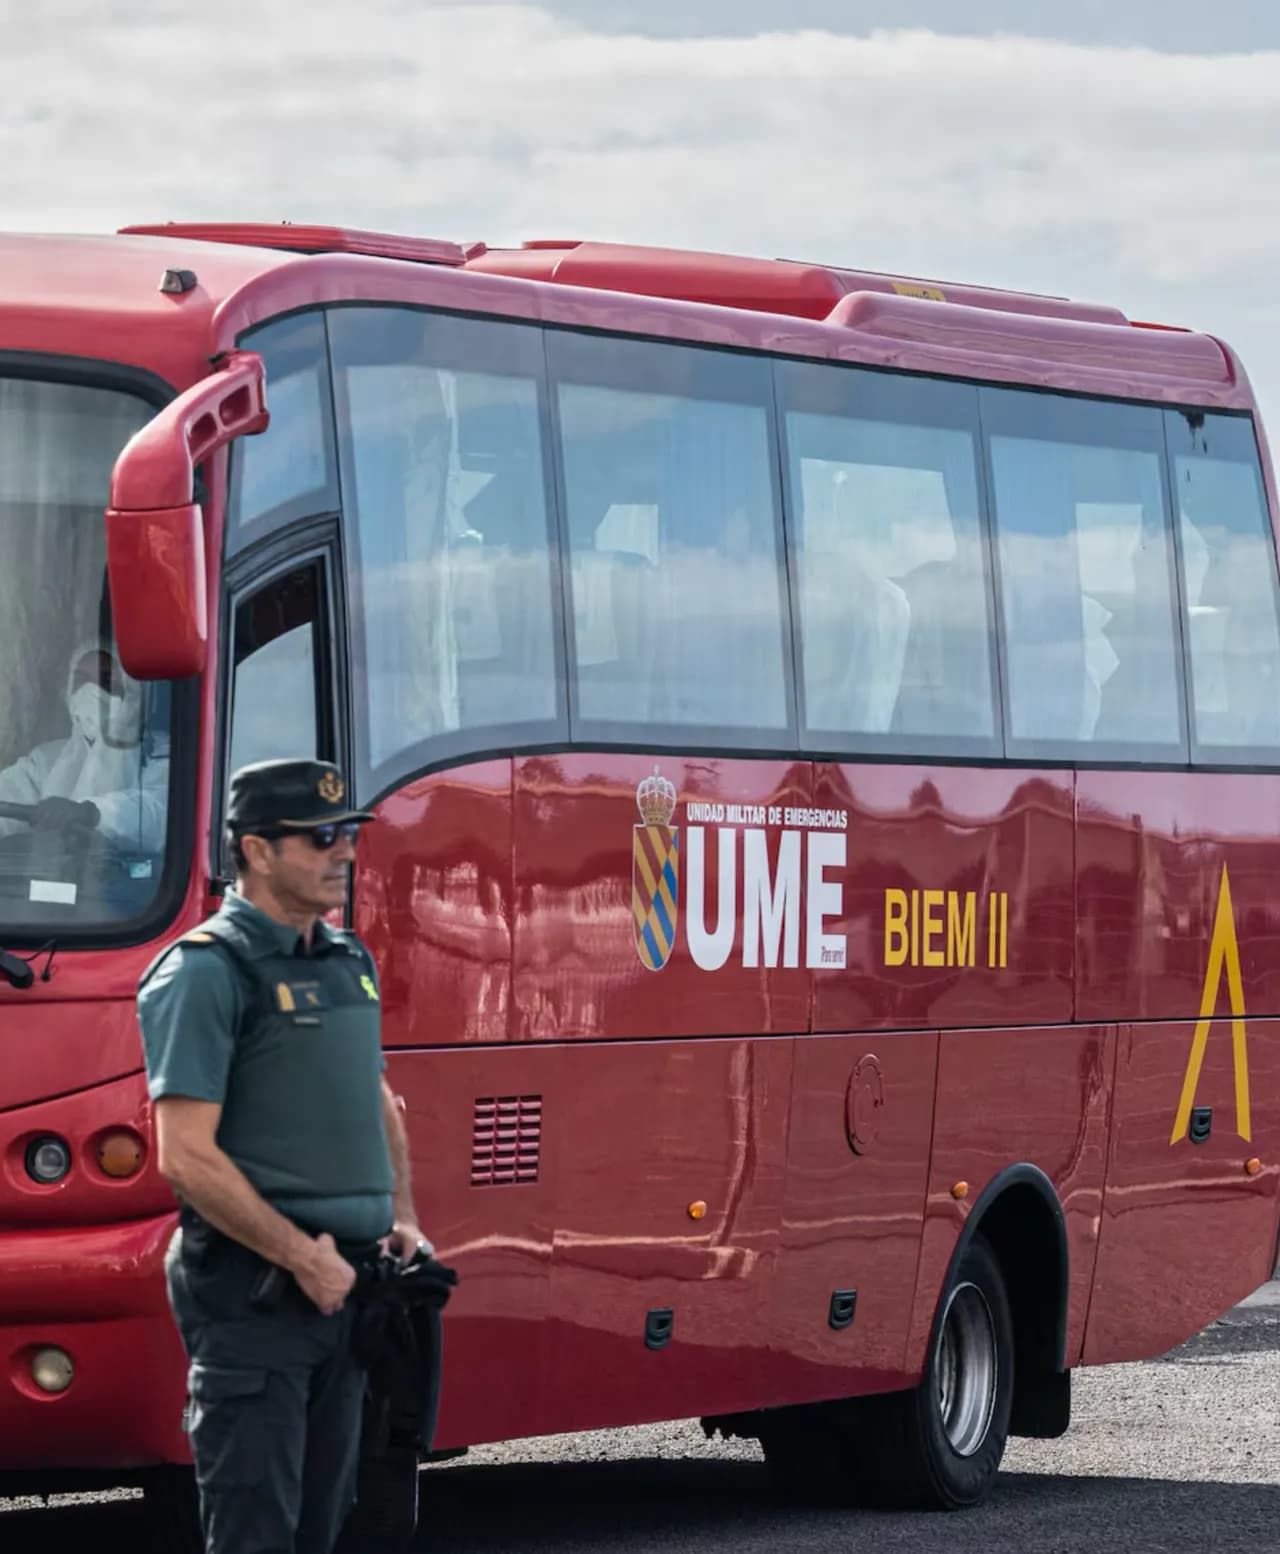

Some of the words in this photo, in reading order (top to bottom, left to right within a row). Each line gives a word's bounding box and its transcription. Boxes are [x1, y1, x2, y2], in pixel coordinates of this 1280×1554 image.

[686, 802, 723, 822] UNIDAD
[726, 804, 766, 824] MILITAR
[768, 806, 782, 825] DE
[784, 807, 848, 828] EMERGENCIAS
[685, 826, 848, 971] UME
[884, 888, 976, 967] BIEM
[988, 892, 1007, 968] II
